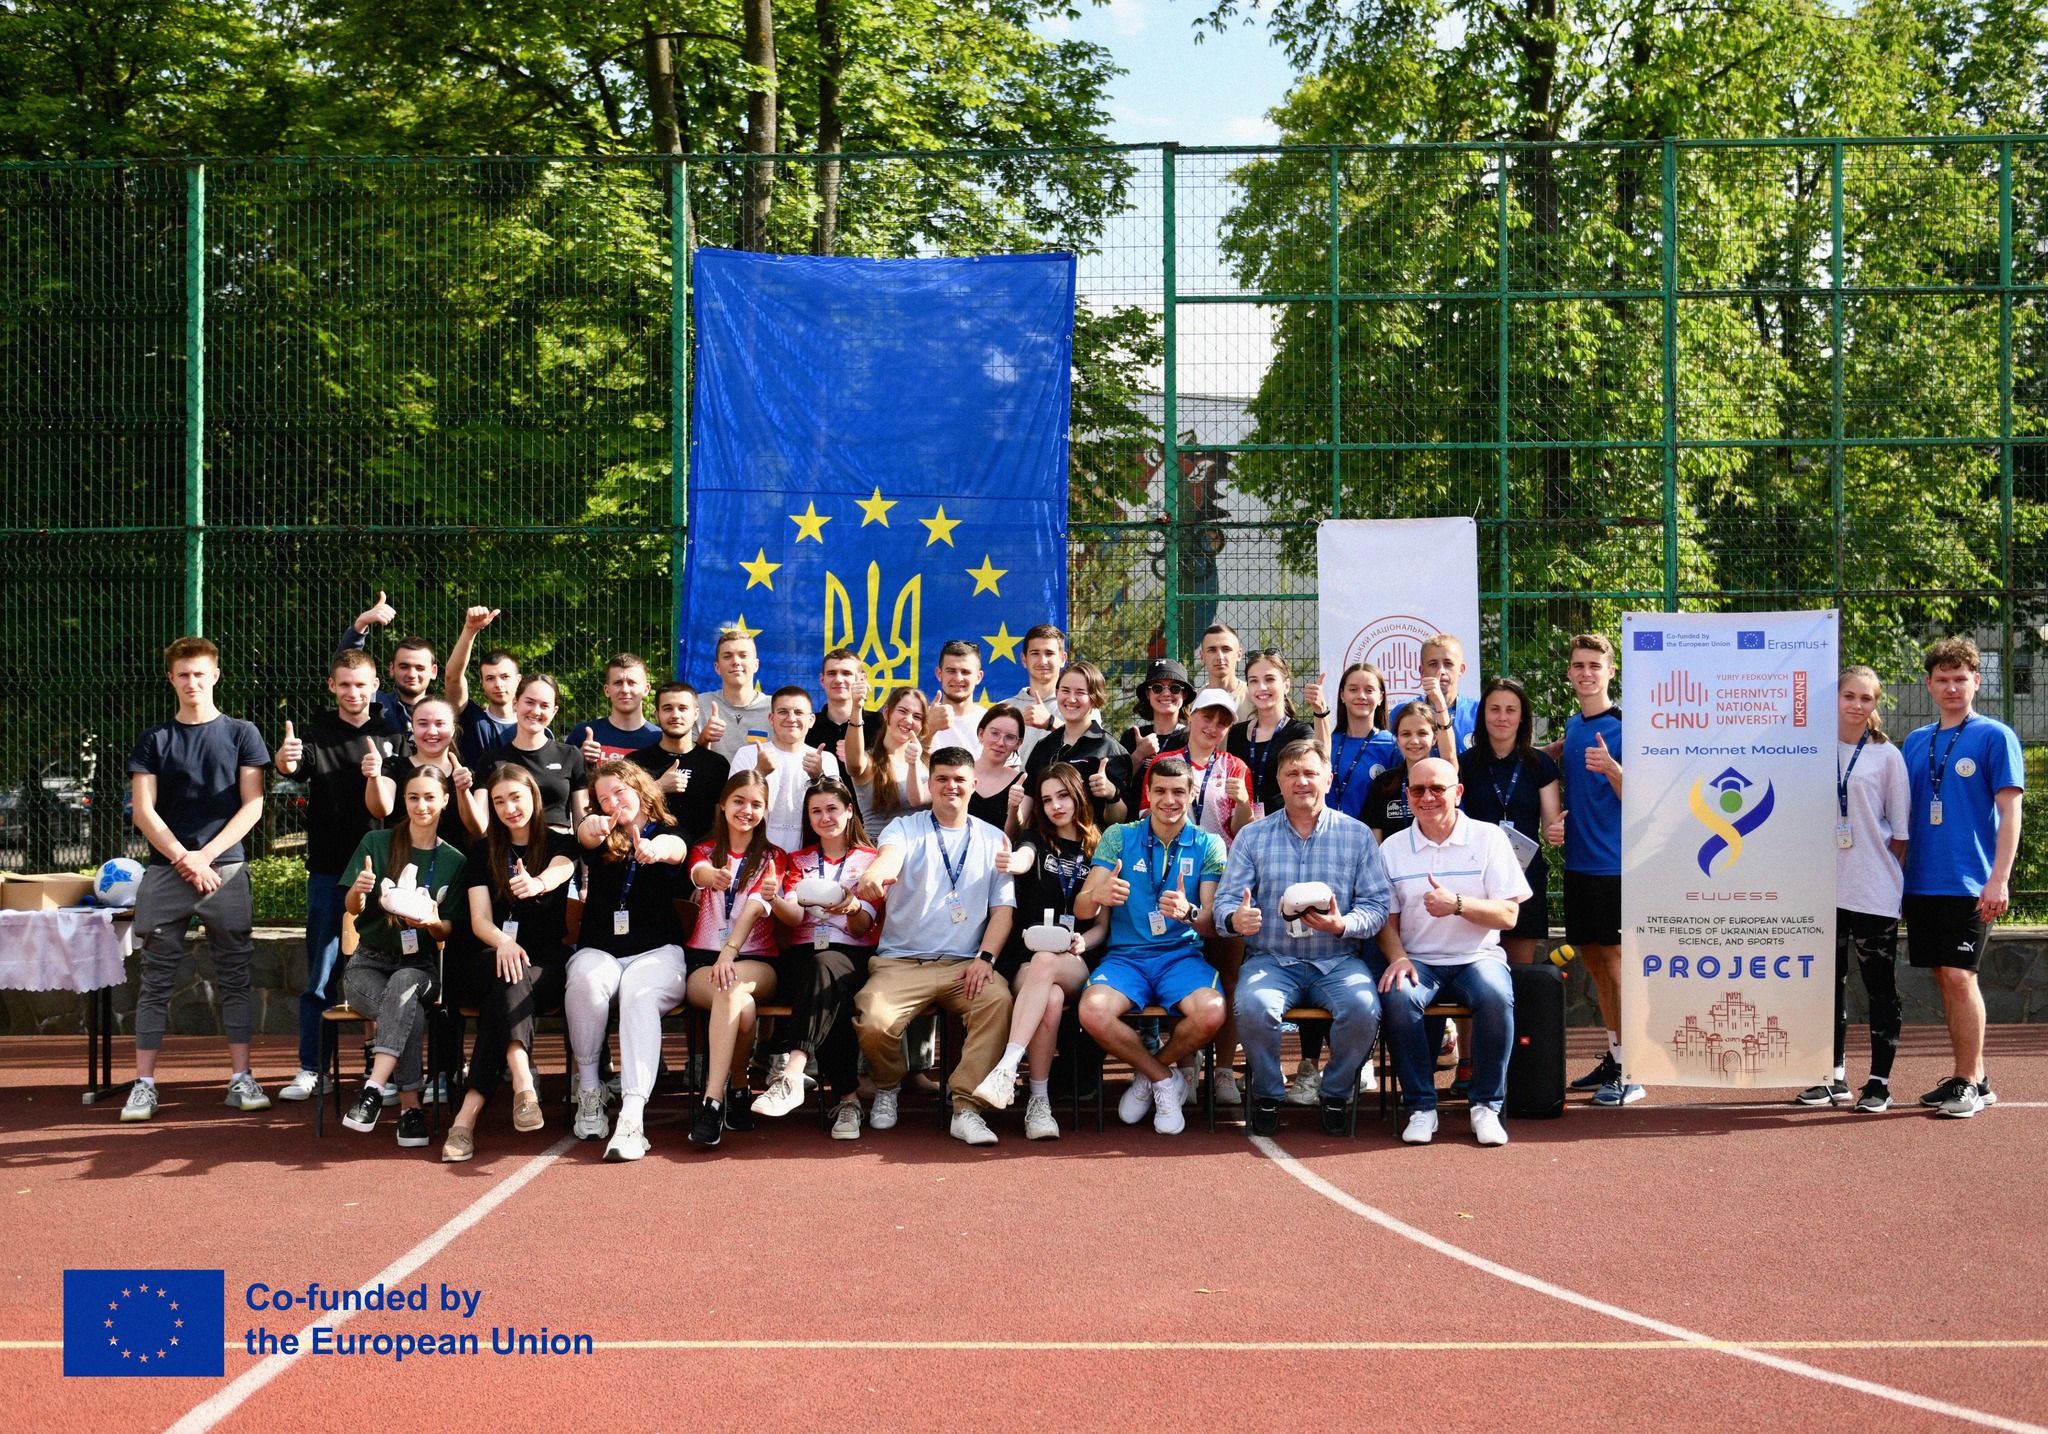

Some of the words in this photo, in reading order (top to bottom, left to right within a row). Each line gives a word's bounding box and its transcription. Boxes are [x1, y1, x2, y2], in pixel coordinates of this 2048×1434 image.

[1353, 636, 1372, 663] ЦЬКИЙ
[1768, 639, 1829, 650] Erasmus+
[1716, 673, 1740, 681] YURIY
[1741, 673, 1789, 681] FEDKOVYCH
[1716, 688, 1788, 699] CHERNIVTSI
[1795, 672, 1806, 726] UKRAINE
[1716, 701, 1778, 712] NATIONAL
[1651, 712, 1710, 730] CHNU
[1716, 714, 1788, 725] UNIVERSITY
[1641, 745, 1680, 756] Jean
[1685, 745, 1746, 755] Monnet
[1751, 744, 1818, 755] Modules
[1646, 916, 1710, 924] INTEGRATION
[1713, 916, 1726, 924] OF
[1729, 916, 1778, 924] EUROPEAN
[1781, 915, 1815, 924] VALUES
[1636, 926, 1645, 934] IN
[1648, 926, 1666, 934] THE
[1669, 927, 1702, 935] FIELDS
[1705, 927, 1718, 935] OF
[1721, 927, 1769, 935] UKRAINIAN
[1771, 926, 1824, 935] EDUCATION,
[1678, 937, 1722, 946] SCIENCE,
[1725, 937, 1744, 945] AND
[1747, 937, 1785, 945] SPORTS
[1643, 954, 1814, 979] PROJECT
